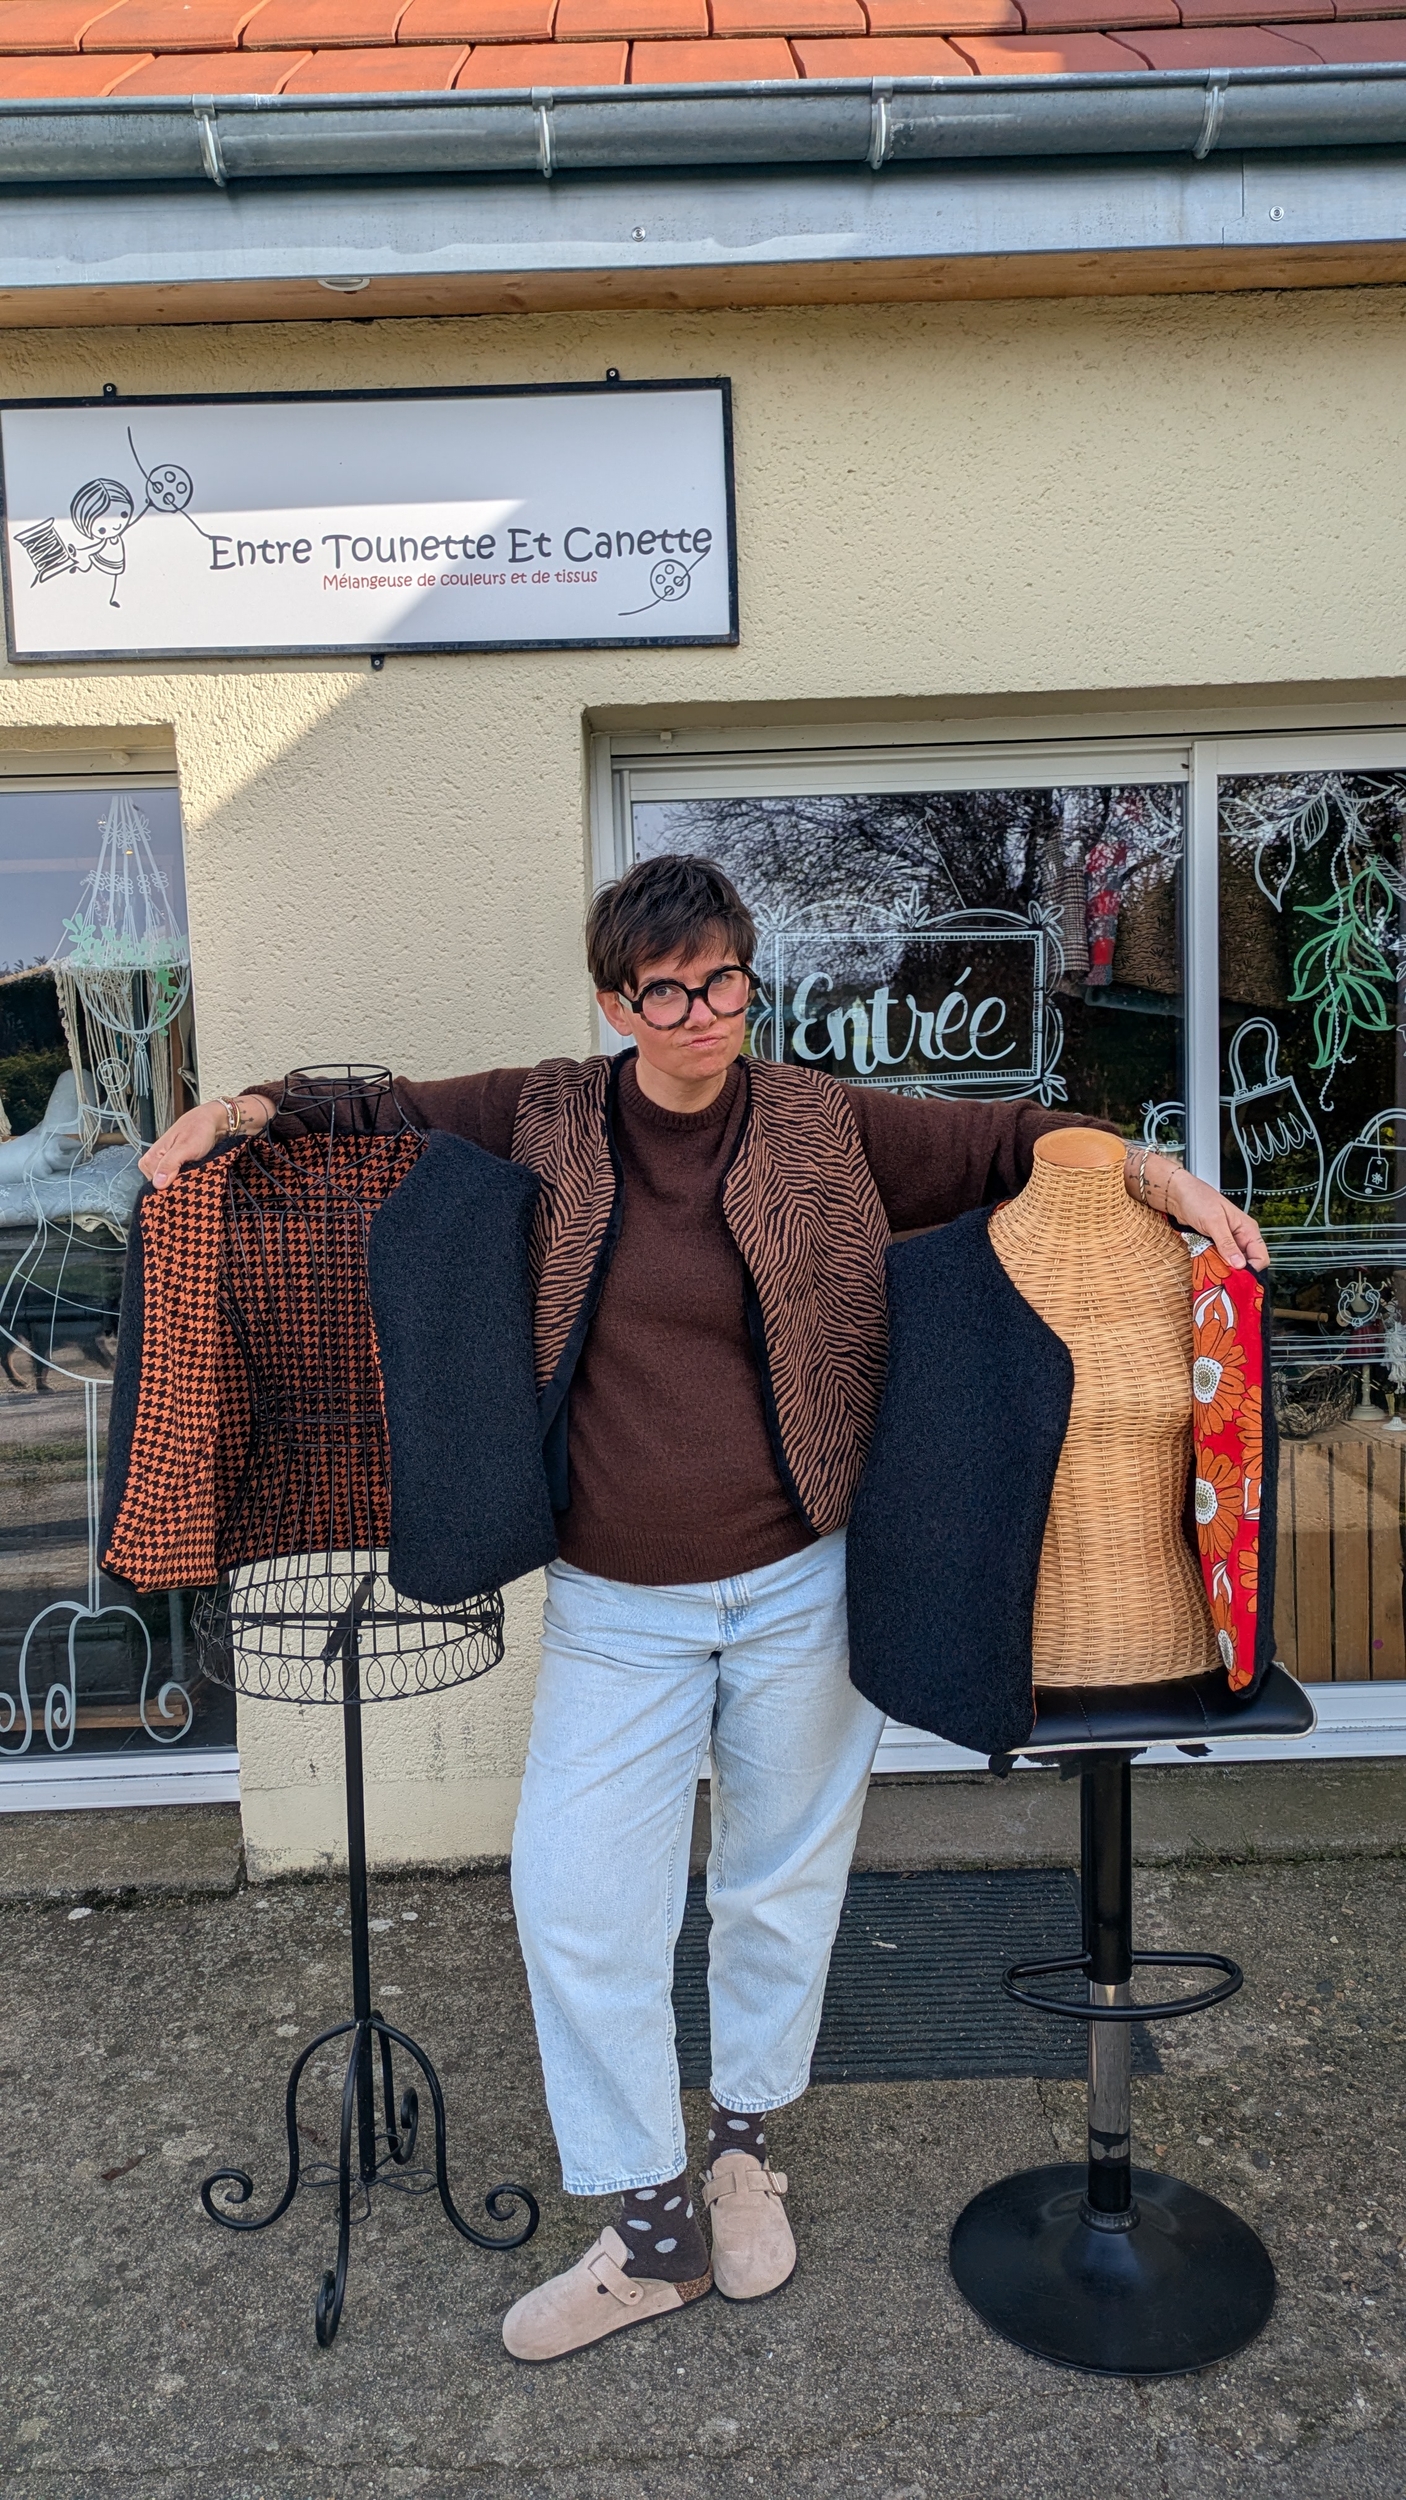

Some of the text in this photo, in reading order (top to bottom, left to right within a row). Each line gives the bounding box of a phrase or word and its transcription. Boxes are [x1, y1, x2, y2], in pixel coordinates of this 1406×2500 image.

[209, 526, 713, 571] Entre Tounette Et Canette
[322, 568, 599, 591] Mélangeuse de couleurs et de tissus
[791, 966, 1017, 1075] Entrée
